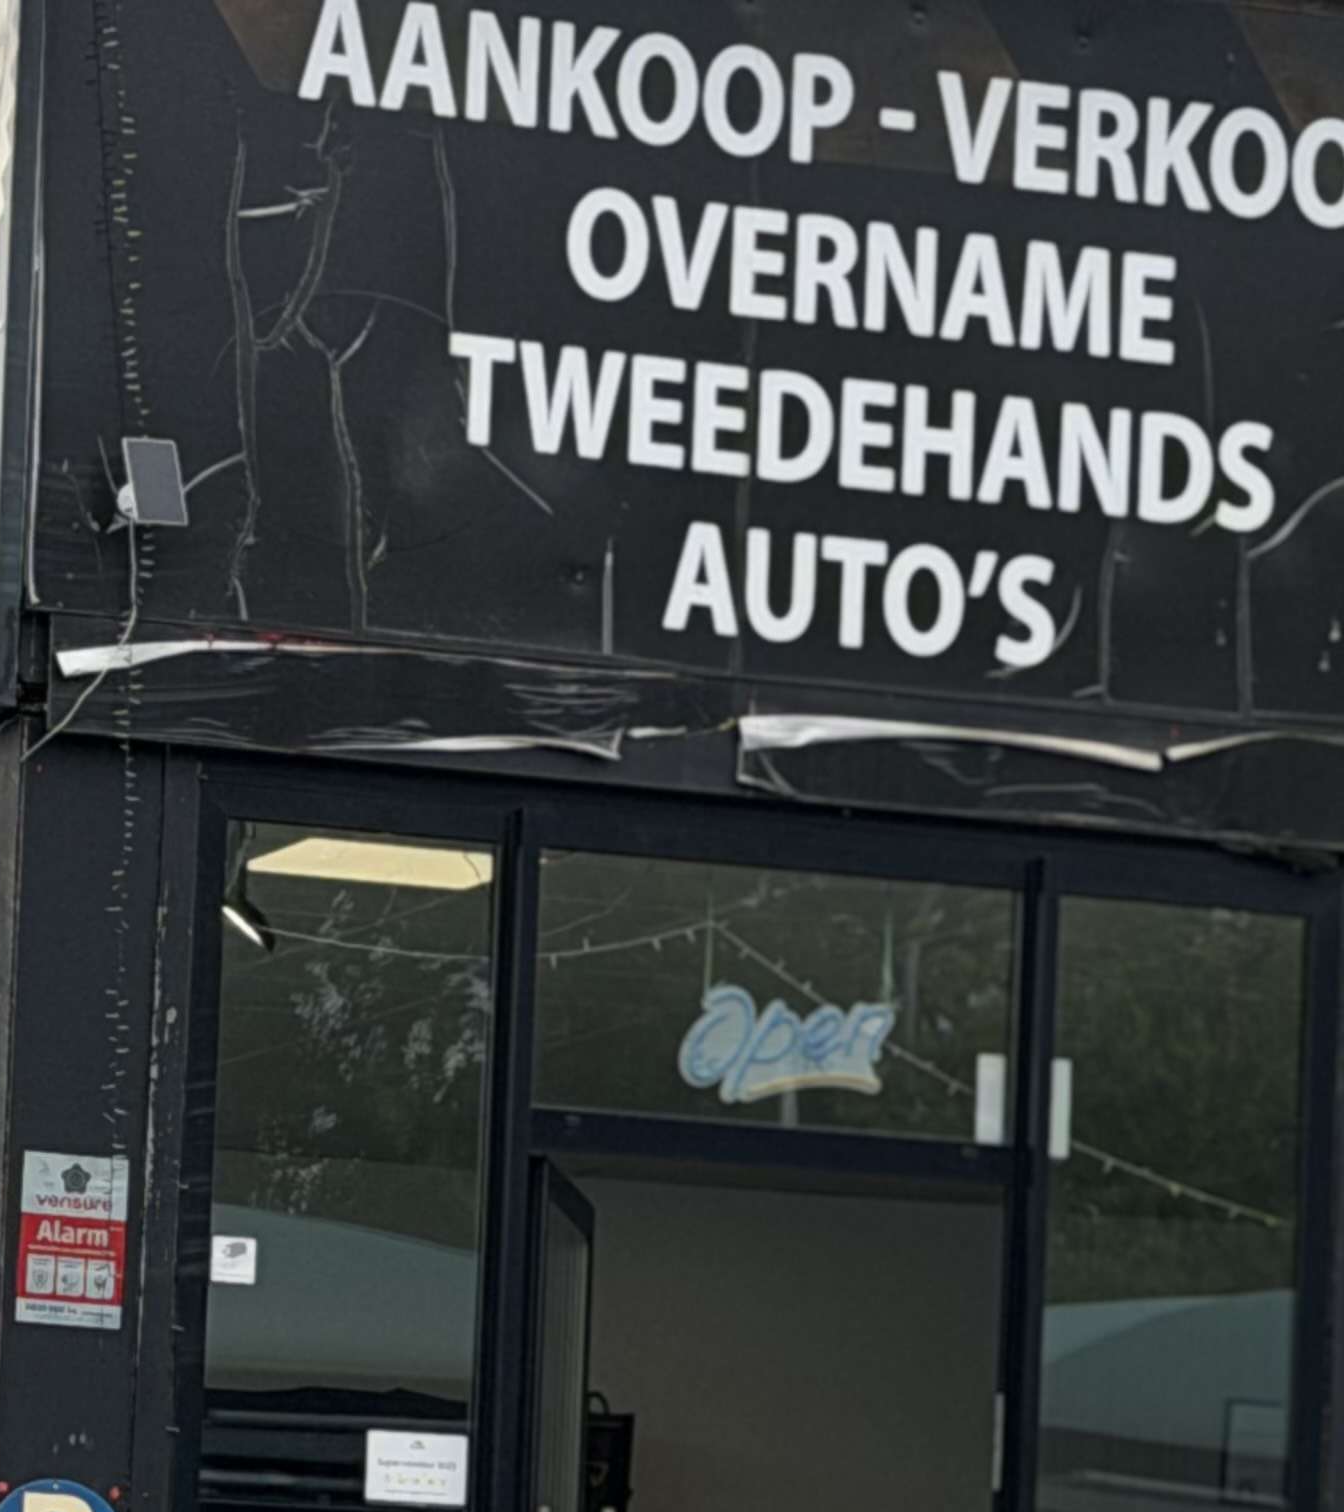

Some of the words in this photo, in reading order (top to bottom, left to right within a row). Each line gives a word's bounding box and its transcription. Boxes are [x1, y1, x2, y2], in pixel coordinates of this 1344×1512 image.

[299, 0, 853, 163] AANKOOP
[567, 187, 1176, 365] OVERNAME
[449, 332, 1274, 533] TWEEDEHANDS
[662, 522, 1056, 668] AUTO'S
[680, 985, 897, 1100] Open
[36, 1219, 109, 1247] Alarm
